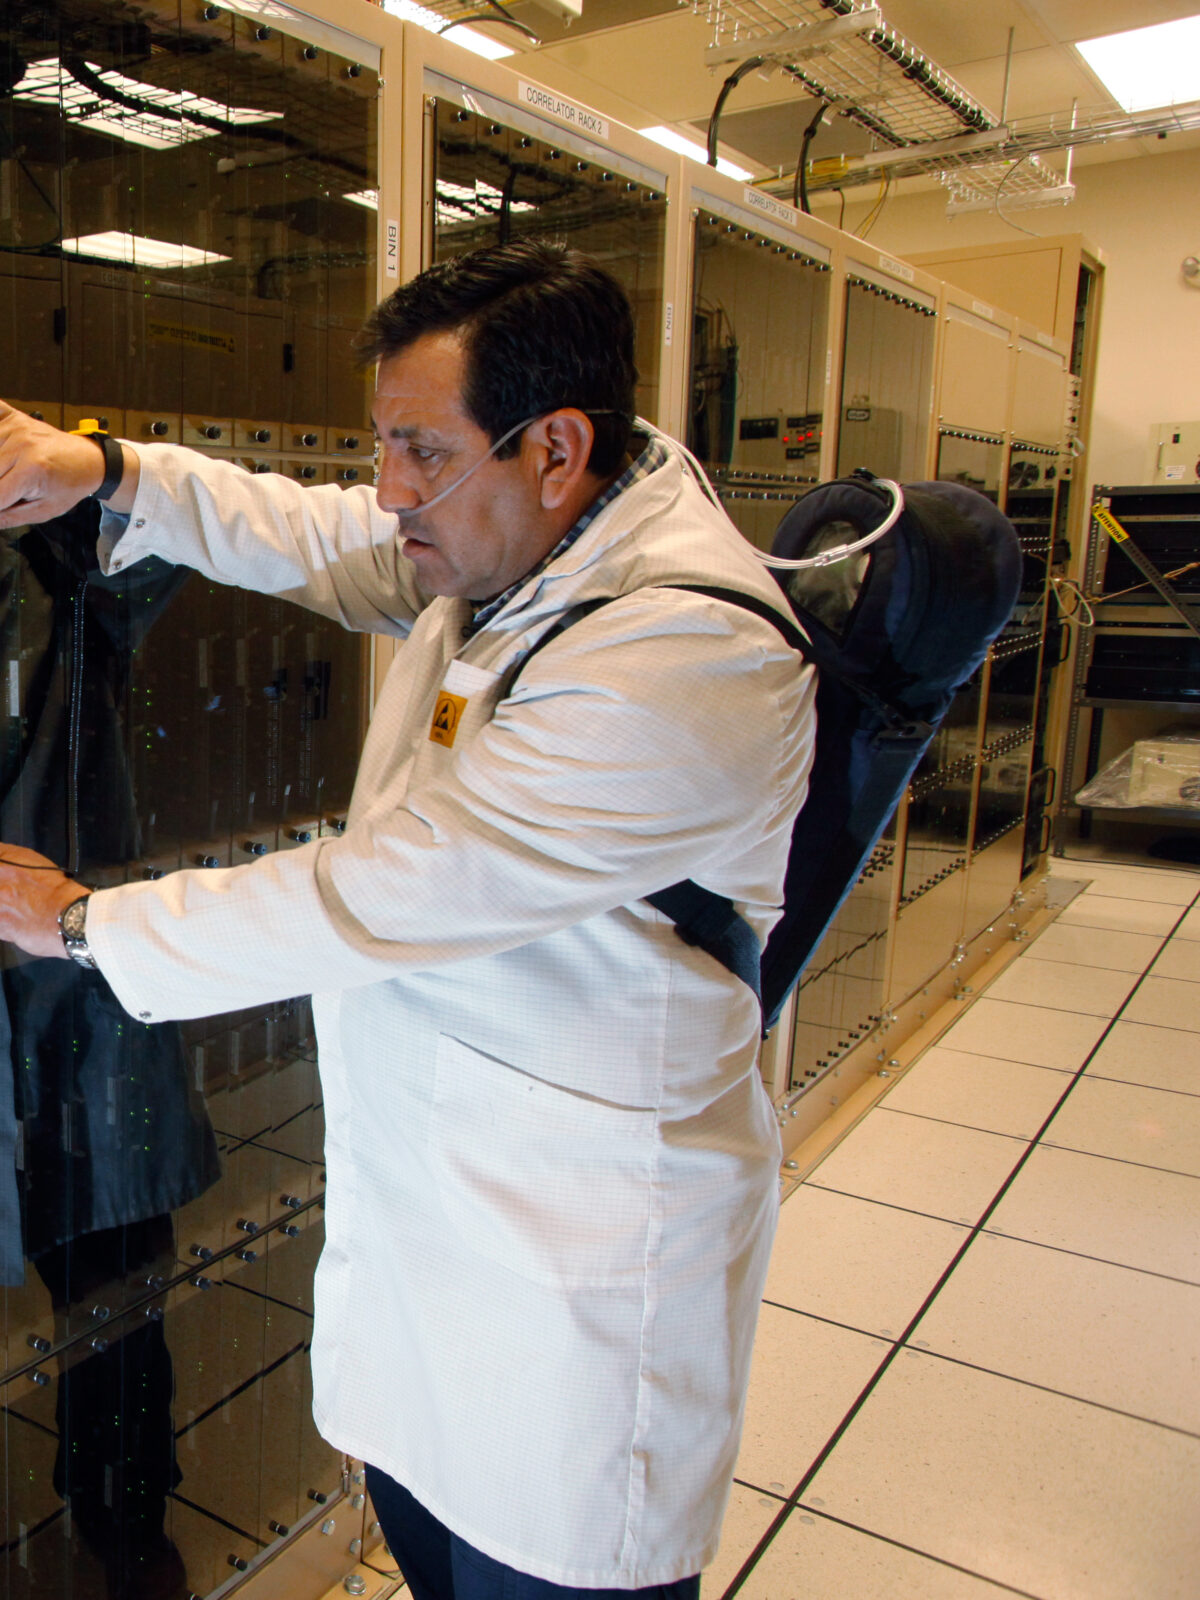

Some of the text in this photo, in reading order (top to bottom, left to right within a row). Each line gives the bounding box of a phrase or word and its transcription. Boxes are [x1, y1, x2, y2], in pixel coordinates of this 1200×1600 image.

[525, 87, 602, 135] CORRELATOR RACK 2
[388, 225, 397, 257] BIN
